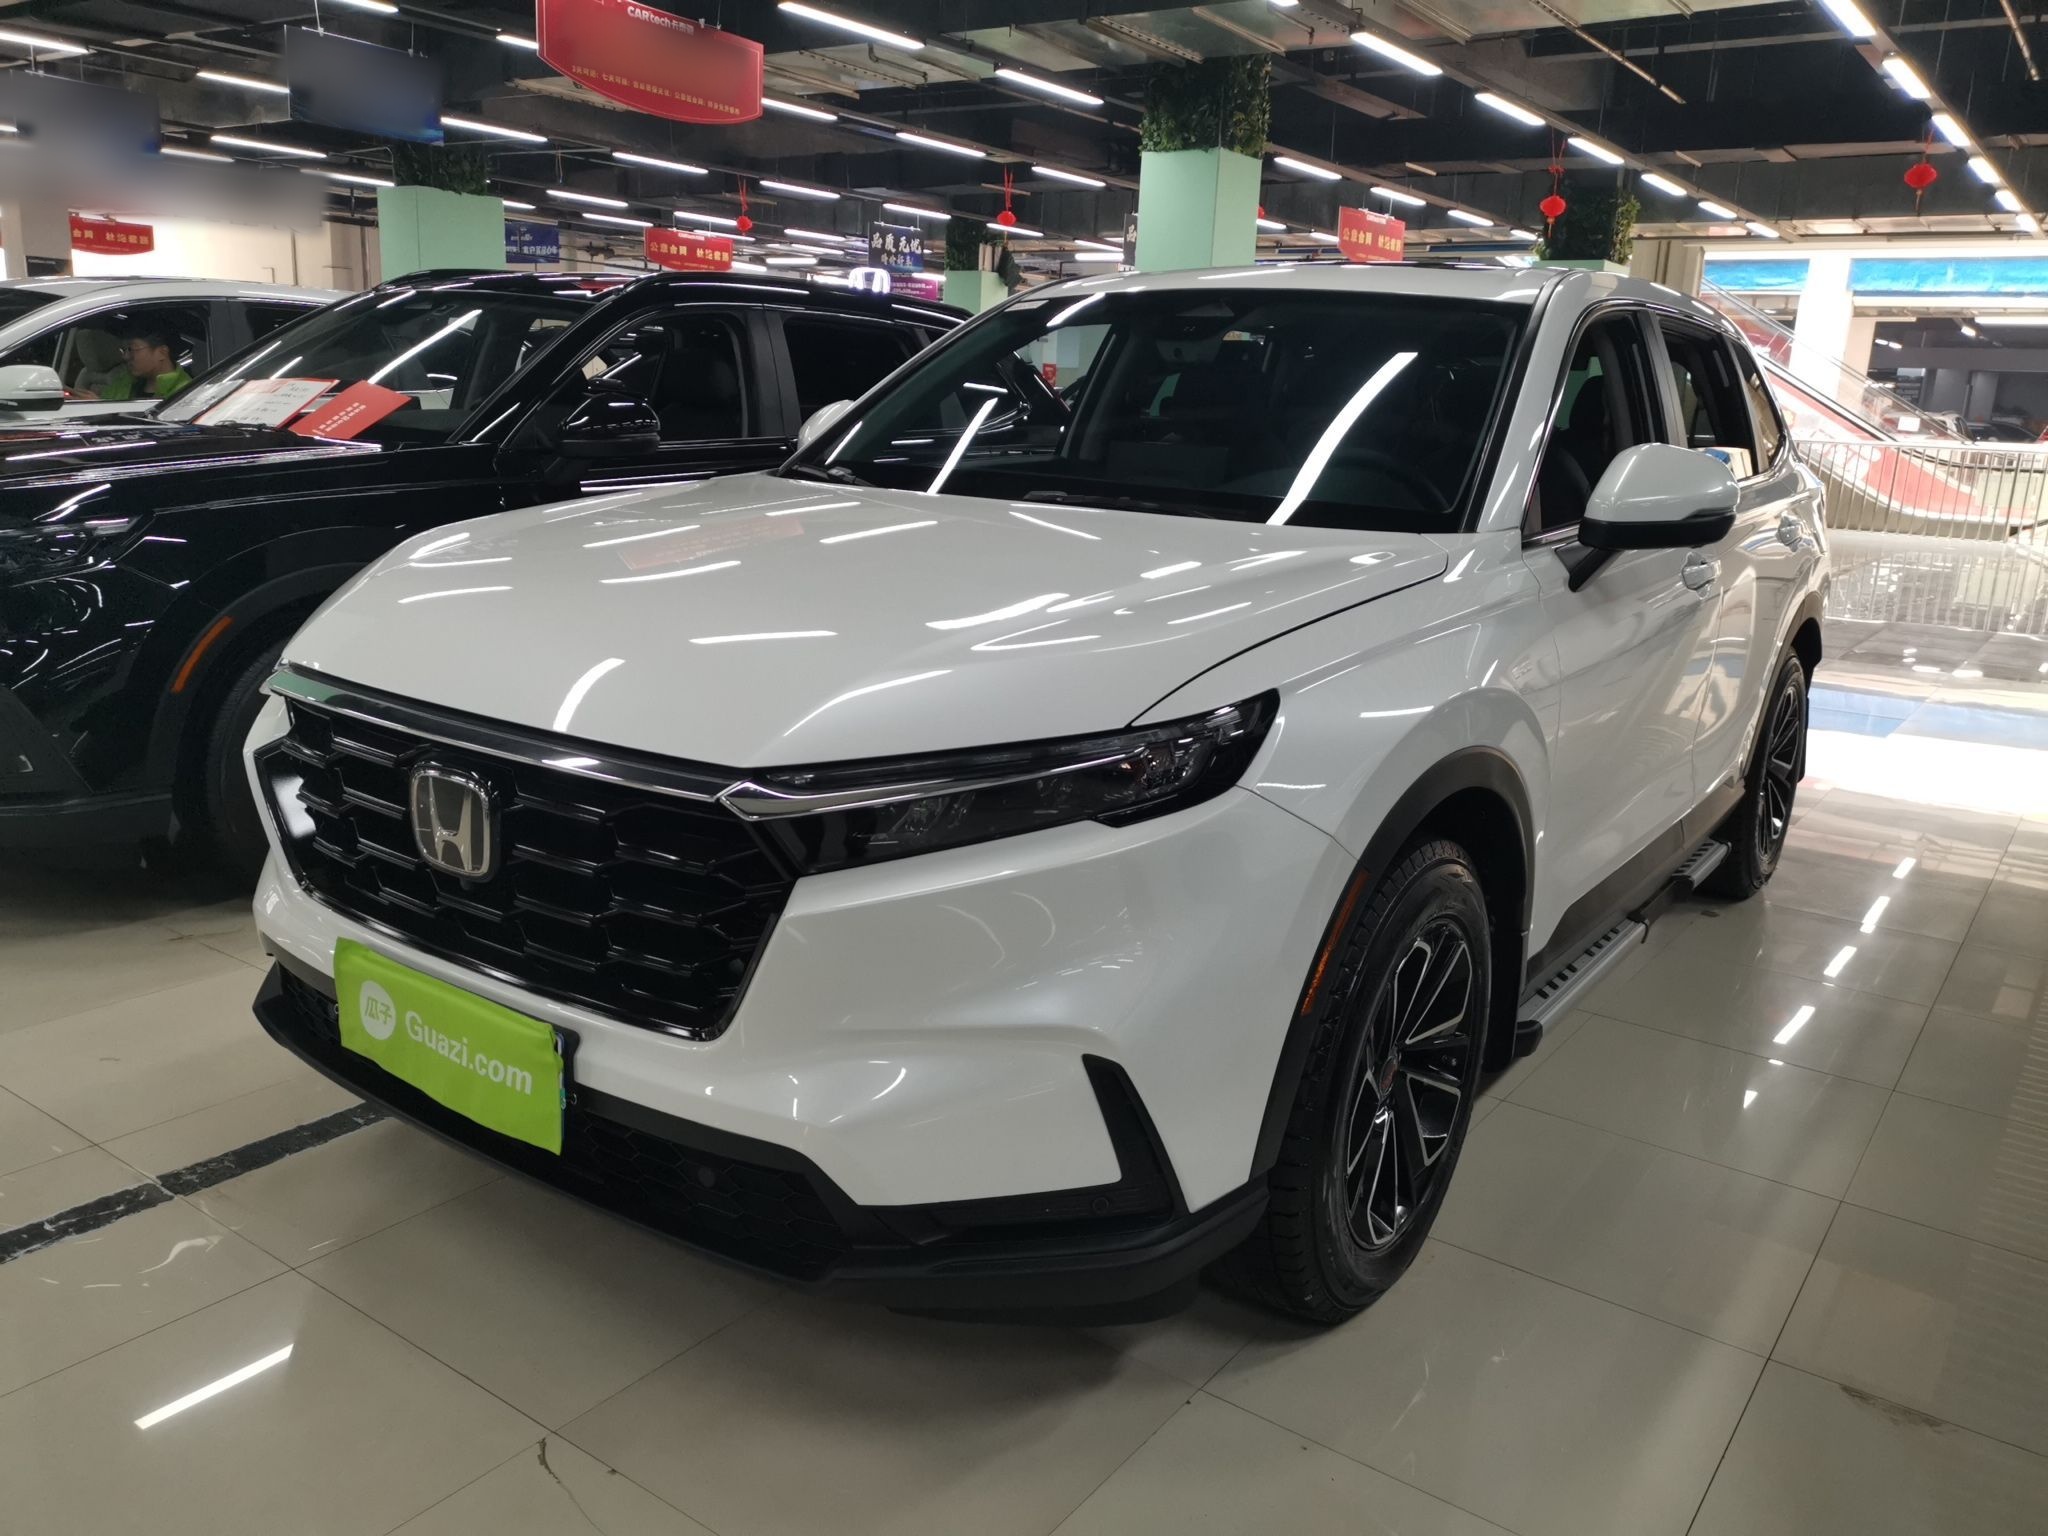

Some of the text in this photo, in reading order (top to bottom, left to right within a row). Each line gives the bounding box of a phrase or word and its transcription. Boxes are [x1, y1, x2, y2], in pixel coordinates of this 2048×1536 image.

[627, 6, 671, 28] CARtech
[365, 996, 393, 1024] 瓜子
[405, 1011, 532, 1096] Guazi.com
